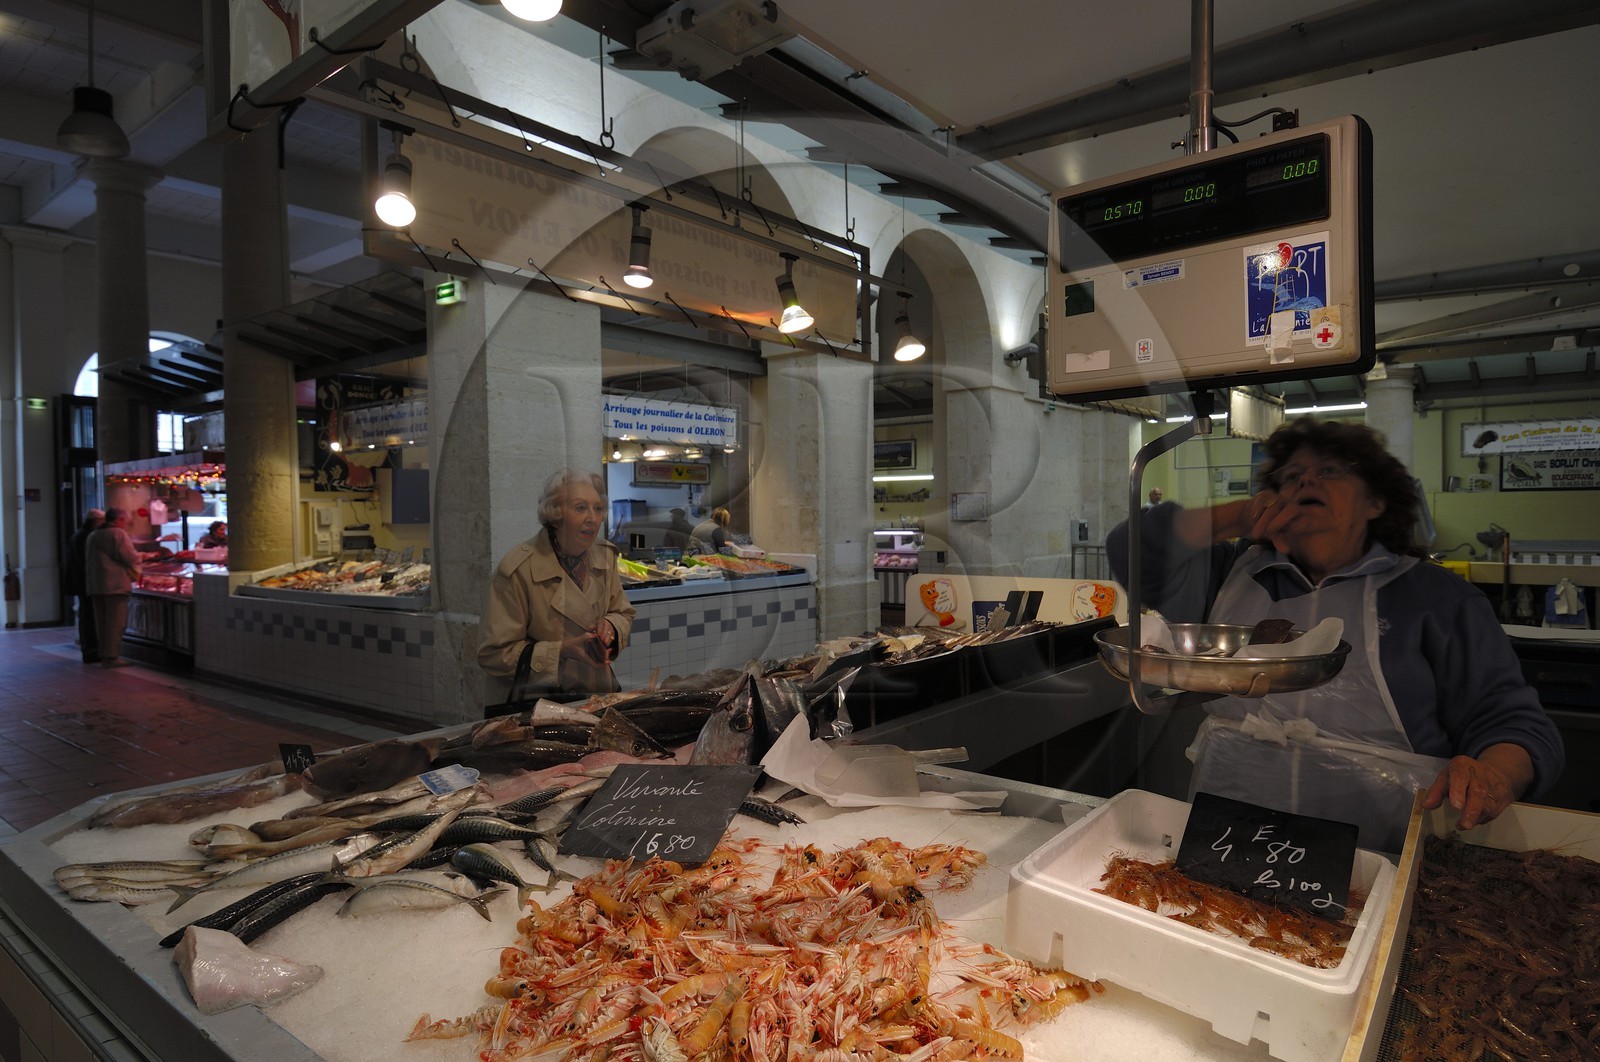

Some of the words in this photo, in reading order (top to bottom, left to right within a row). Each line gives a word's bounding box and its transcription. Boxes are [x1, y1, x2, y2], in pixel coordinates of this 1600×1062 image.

[1282, 158, 1318, 181] 0.00
[1184, 183, 1215, 203] 0.00
[1103, 200, 1142, 221] 0.570
[603, 403, 642, 416] Arrivage
[643, 406, 684, 420] journalier
[685, 411, 694, 421] de
[695, 411, 702, 421] la
[613, 419, 633, 430] Tous
[636, 421, 648, 431] les
[651, 423, 685, 434] poissons
